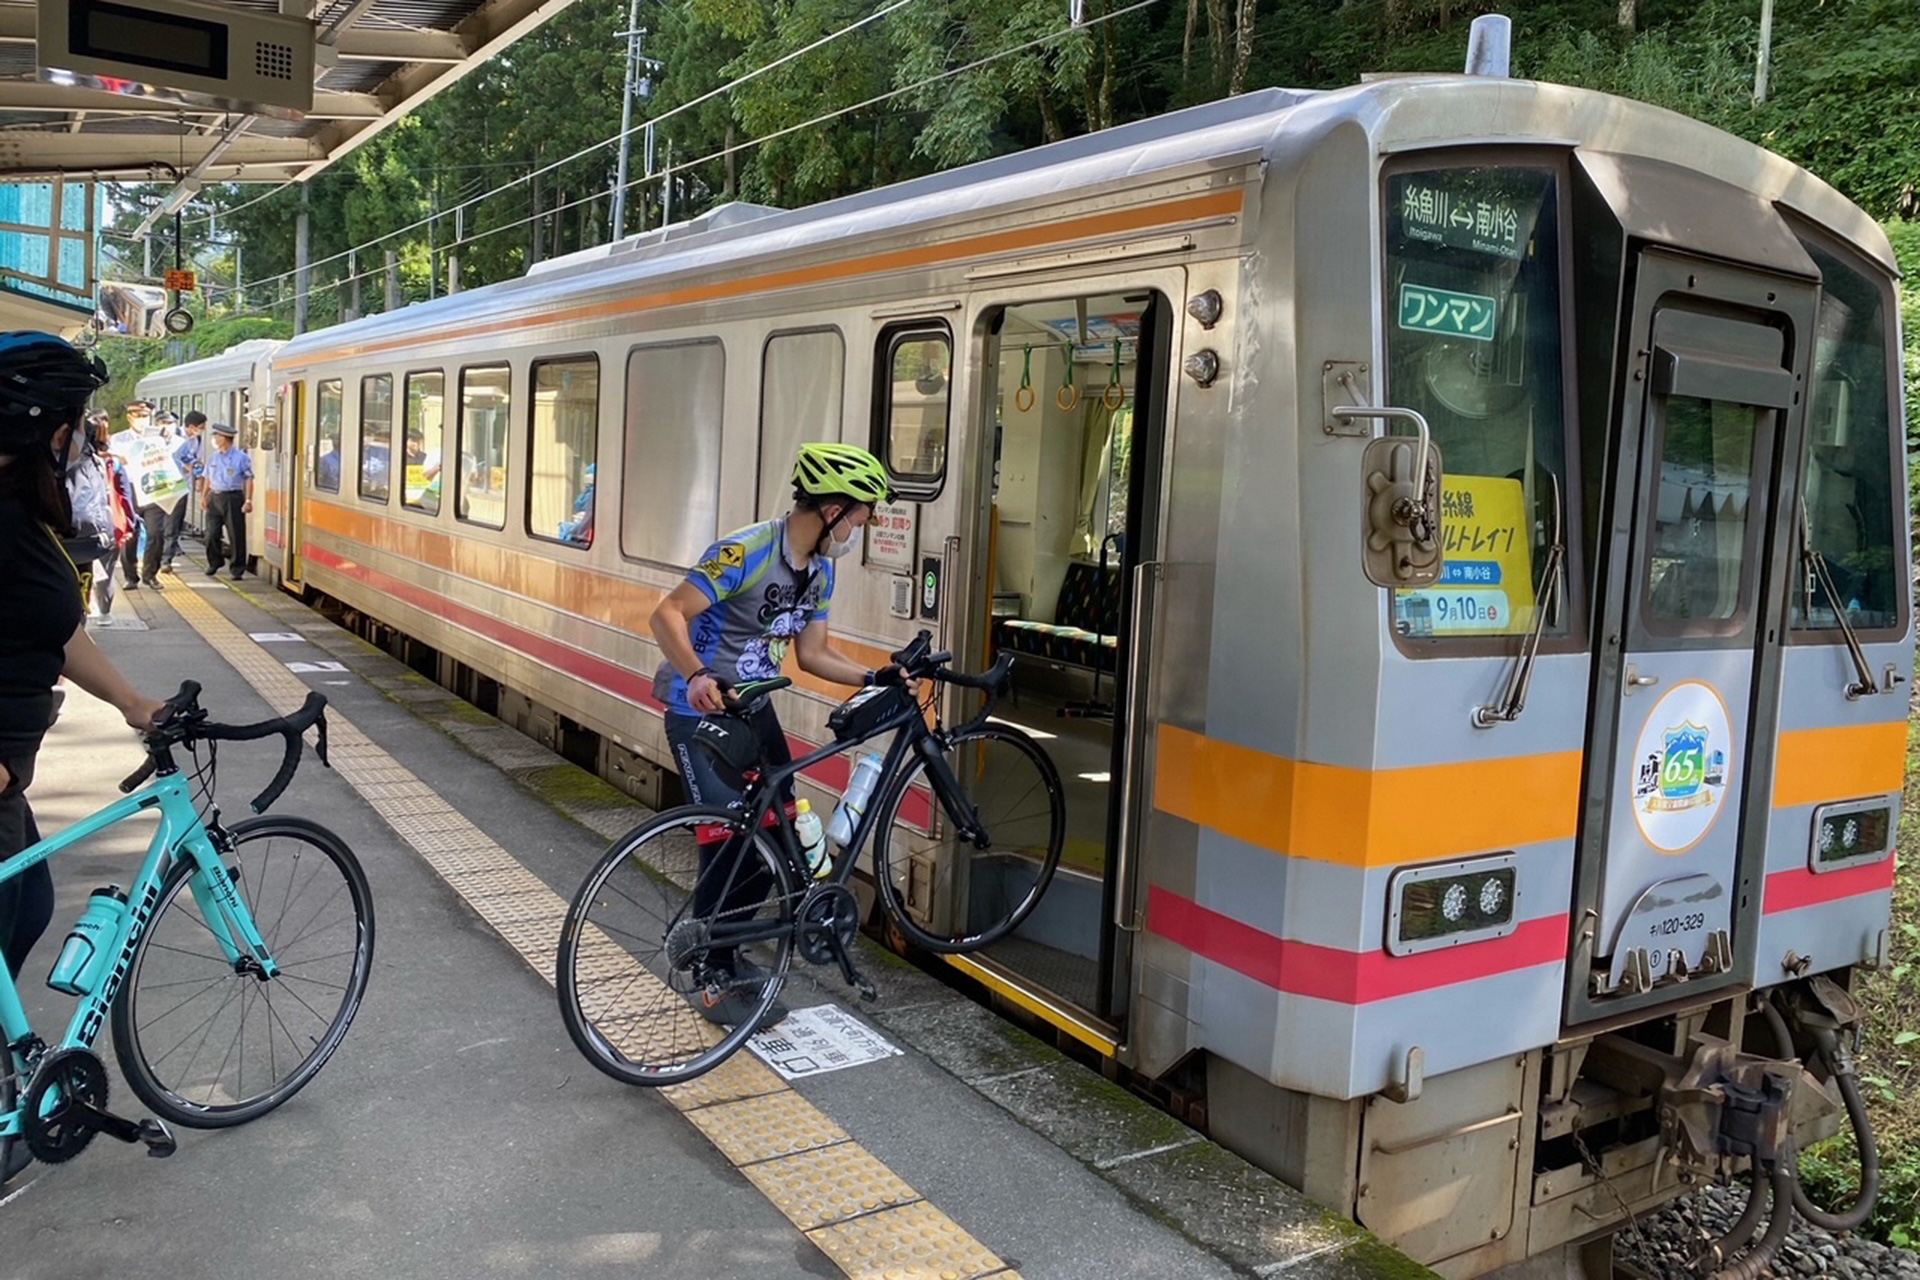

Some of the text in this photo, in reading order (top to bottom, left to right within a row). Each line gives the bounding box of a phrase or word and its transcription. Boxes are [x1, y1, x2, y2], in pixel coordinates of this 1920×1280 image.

[1404, 184, 1518, 242] 糸魚川 南小谷
[1404, 291, 1491, 333] ワンマン
[1664, 747, 1699, 783] 65
[212, 865, 239, 908] Bianchi
[77, 881, 158, 1048] Bianchi
